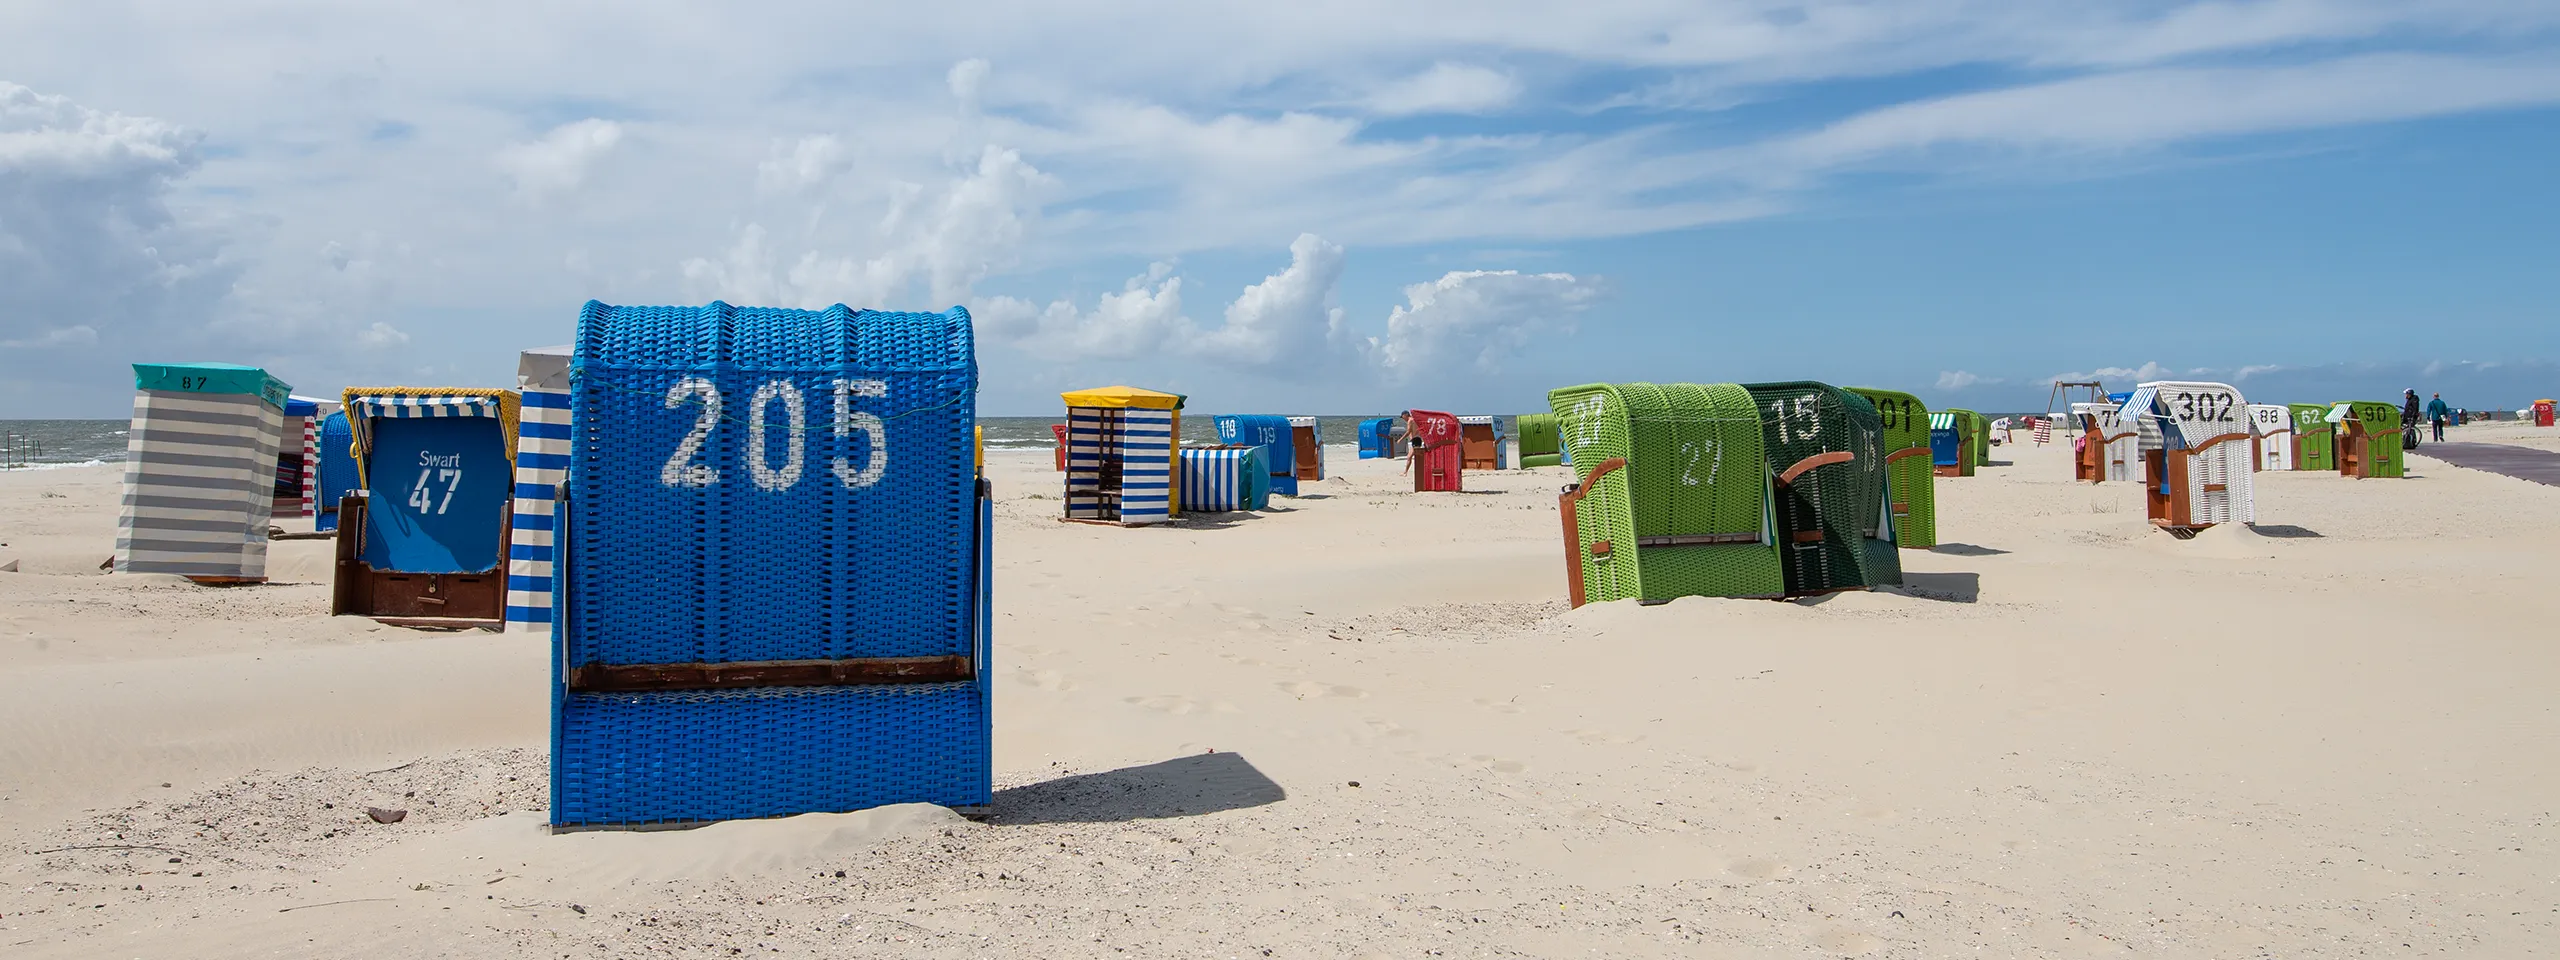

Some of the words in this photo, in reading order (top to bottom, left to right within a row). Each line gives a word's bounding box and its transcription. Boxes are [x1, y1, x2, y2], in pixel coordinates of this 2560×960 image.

[182, 376, 207, 390] 87
[2177, 392, 2234, 422] 302
[2260, 409, 2278, 423] 88
[2365, 406, 2387, 422] 90
[1573, 394, 1605, 447] 27
[1772, 393, 1822, 444] 15
[2102, 410, 2119, 427] 77
[2301, 409, 2320, 424] 62
[660, 376, 888, 492] 205
[1220, 419, 1236, 438] 119
[1257, 426, 1276, 444] 119
[1427, 417, 1446, 435] 78
[1535, 422, 1542, 434] 2
[419, 450, 461, 468] Swart
[1863, 430, 1876, 472] 15
[1682, 440, 1722, 486] 27
[409, 468, 462, 515] 47
